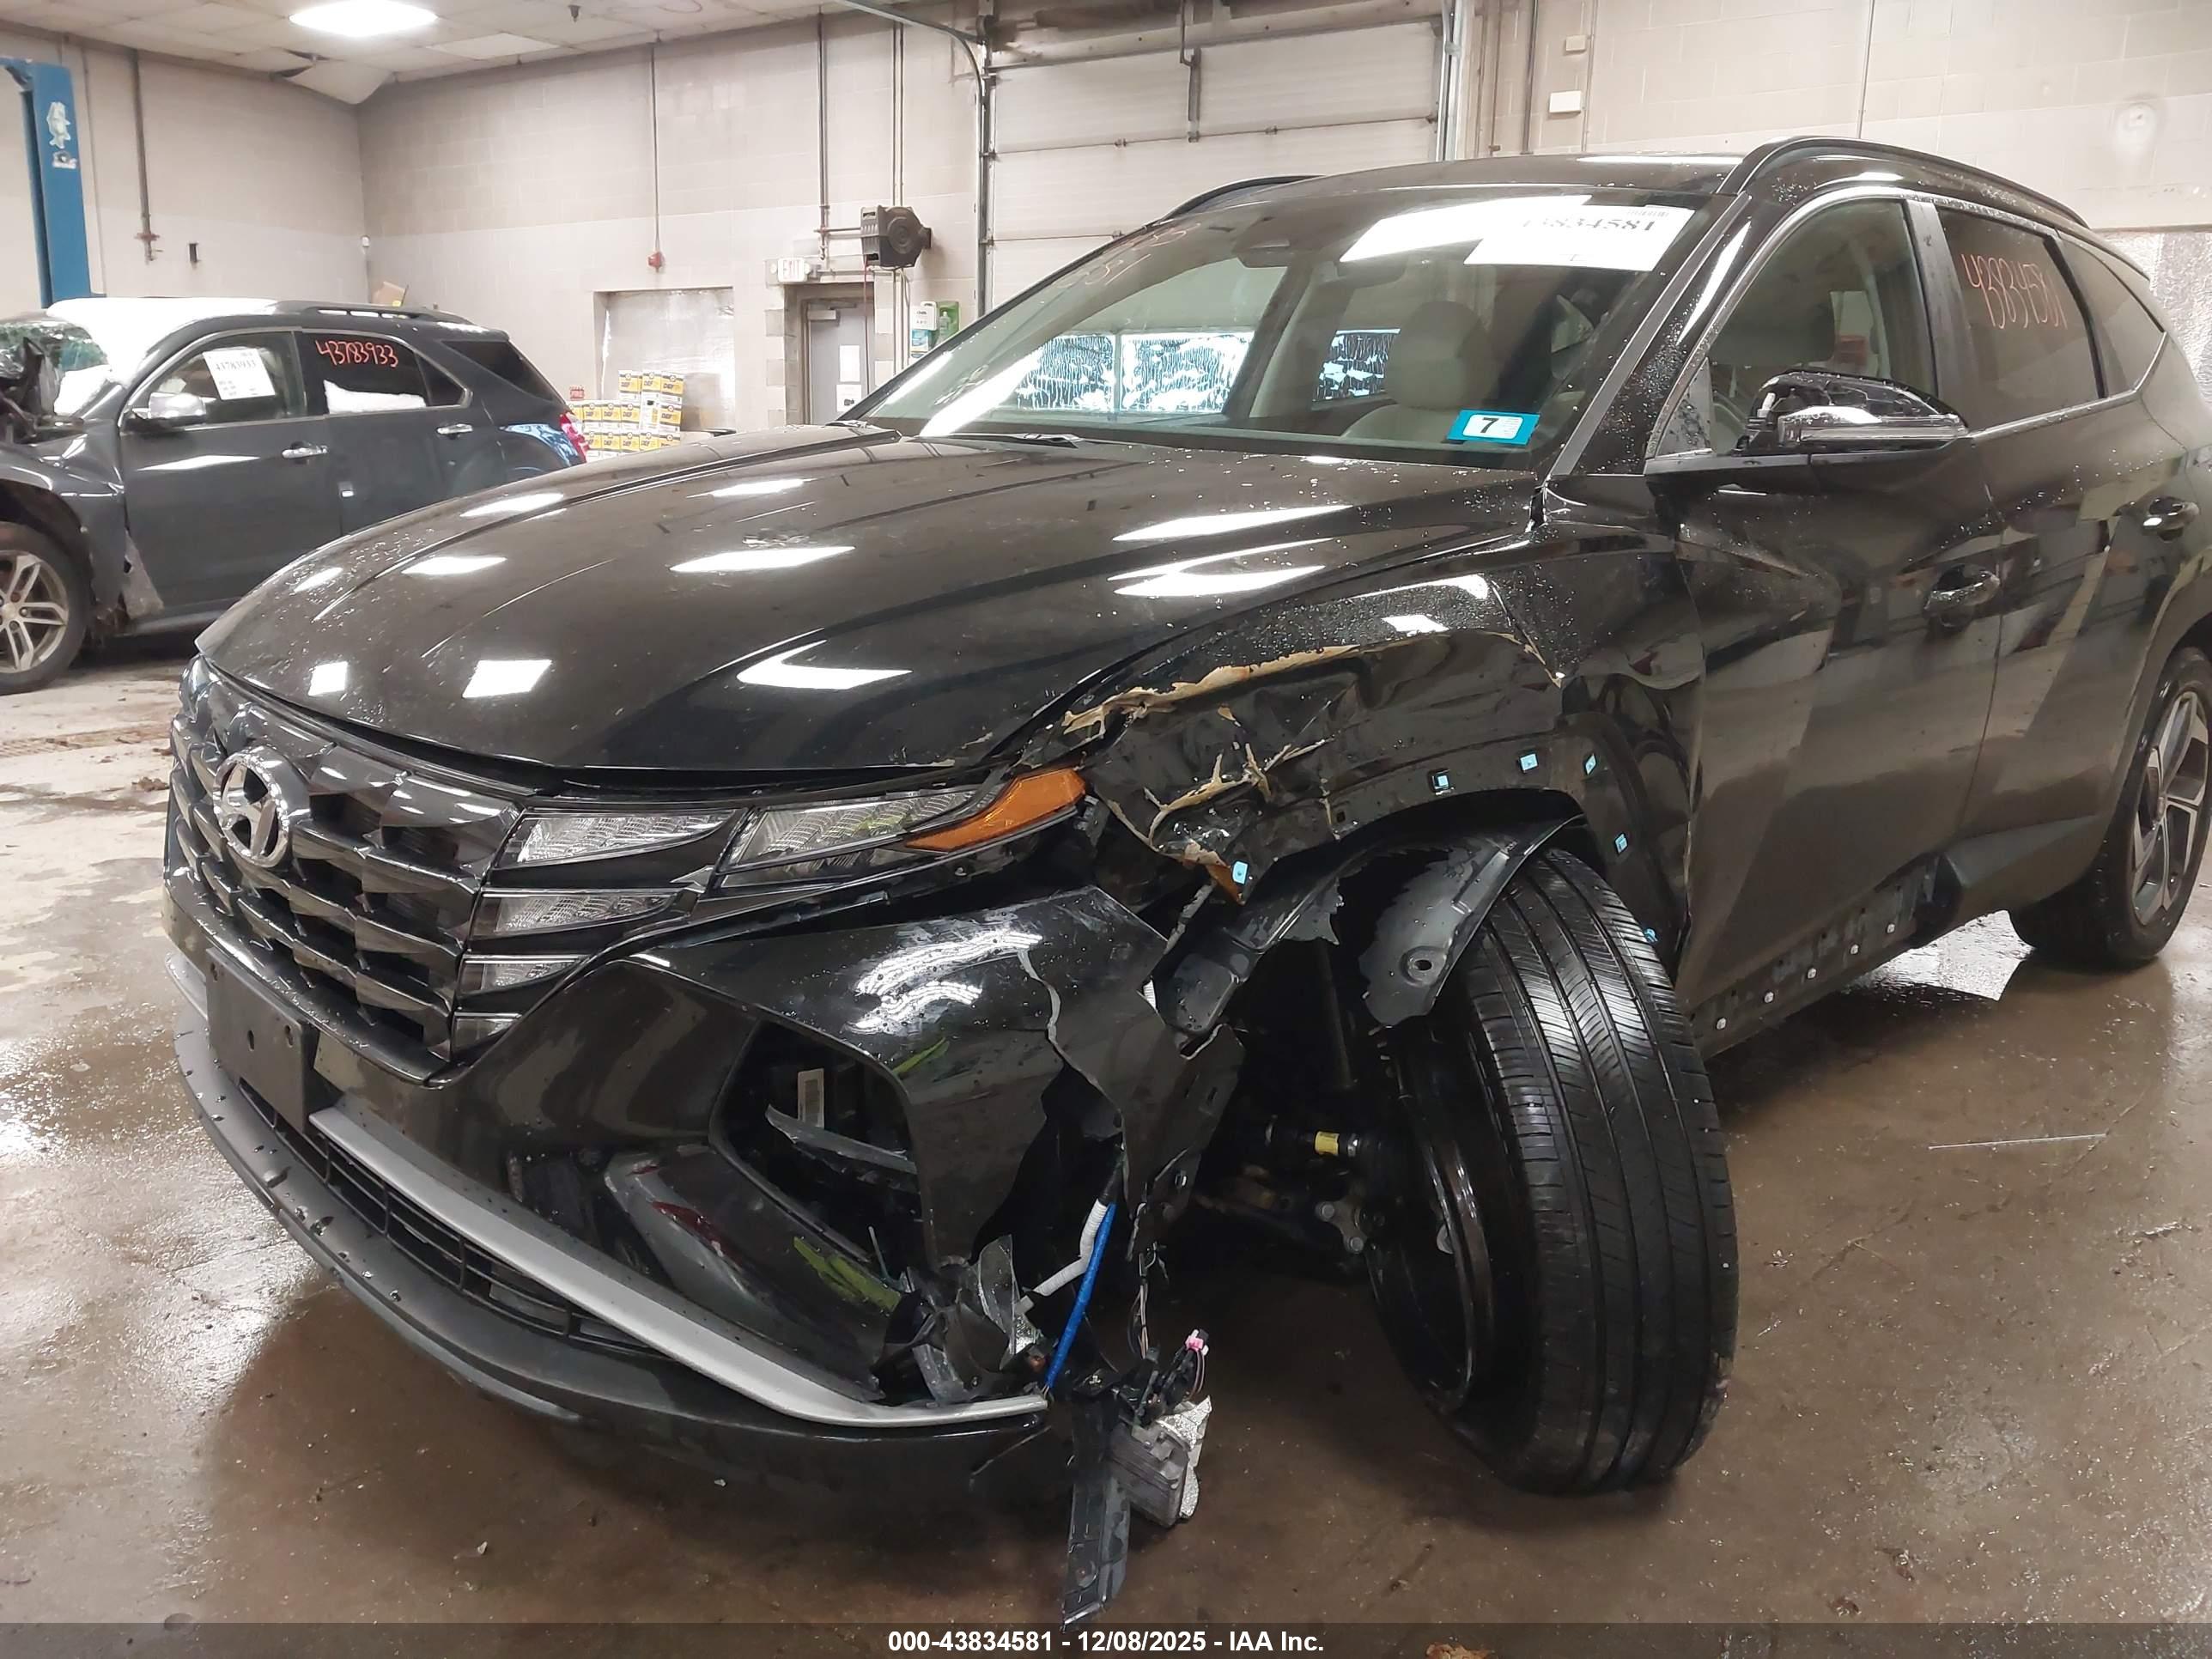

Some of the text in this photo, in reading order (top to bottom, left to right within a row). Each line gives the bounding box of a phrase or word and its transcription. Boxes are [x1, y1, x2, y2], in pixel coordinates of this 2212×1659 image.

[1960, 253, 2068, 330] 43834581
[314, 340, 398, 368] 43783933
[1480, 416, 1499, 434] 7
